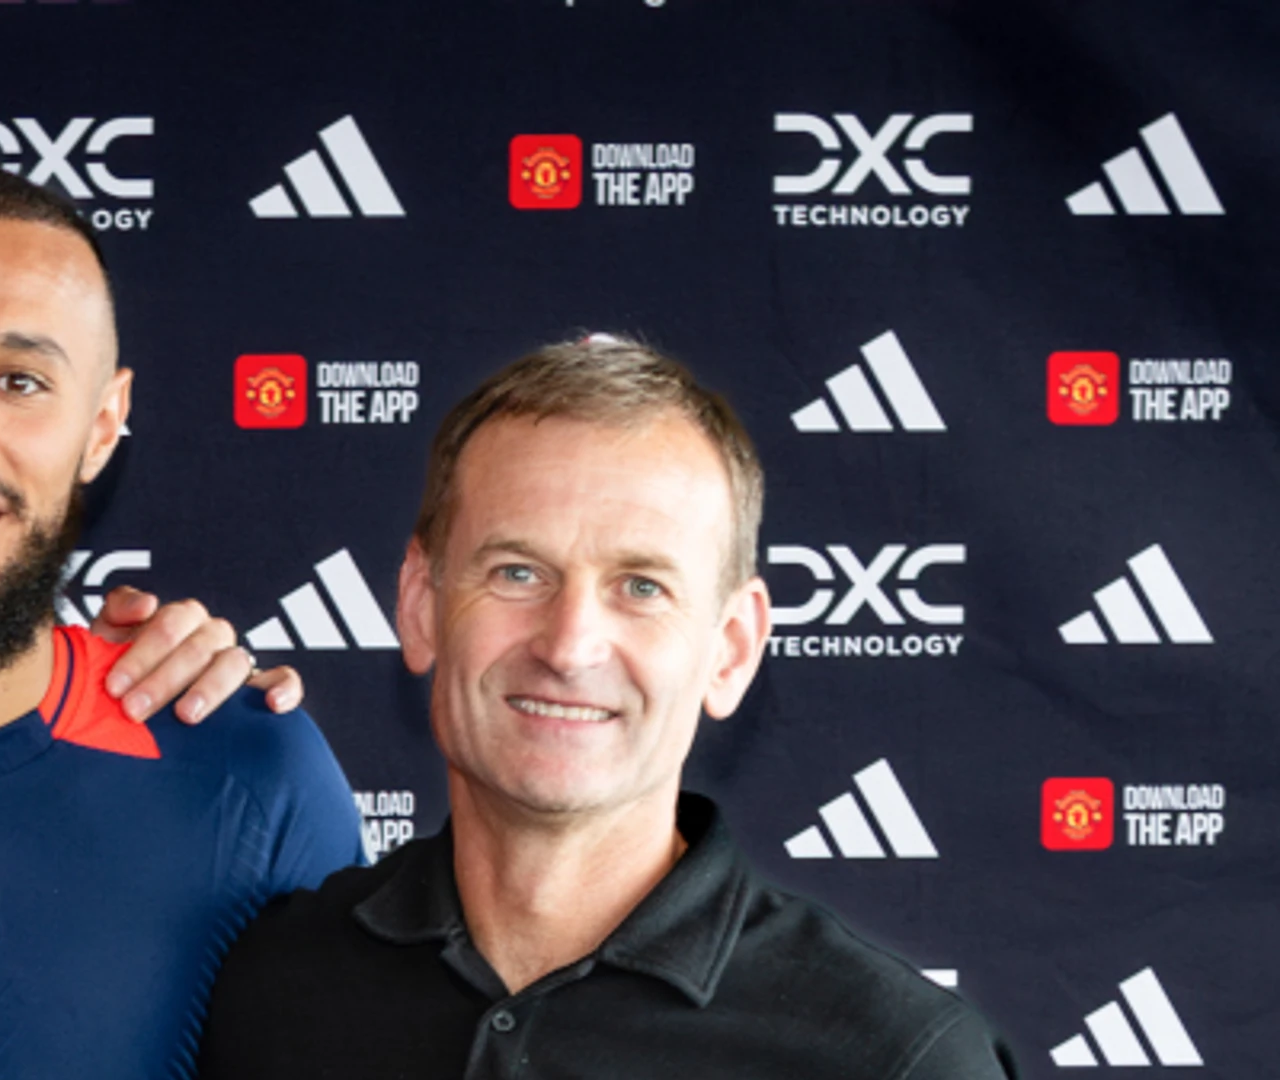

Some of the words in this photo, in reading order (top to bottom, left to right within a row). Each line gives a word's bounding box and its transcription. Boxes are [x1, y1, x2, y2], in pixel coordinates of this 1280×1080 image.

[593, 144, 694, 169] DOWNLOAD
[774, 114, 972, 194] DXC
[593, 172, 640, 205] THE
[644, 172, 693, 205] APP
[774, 205, 969, 226] TECHNOLOGY
[317, 362, 419, 387] DOWNLOAD
[1129, 359, 1231, 384] DOWNLOAD
[318, 391, 365, 423] THE
[369, 390, 418, 423] APP
[1130, 388, 1177, 420] THE
[1180, 388, 1230, 420] APP
[762, 544, 966, 628] DXC
[762, 632, 963, 656] TECHNOLOGY
[1124, 784, 1224, 810] DOWNLOAD
[1124, 813, 1171, 845] THE
[1175, 813, 1223, 845] APP
